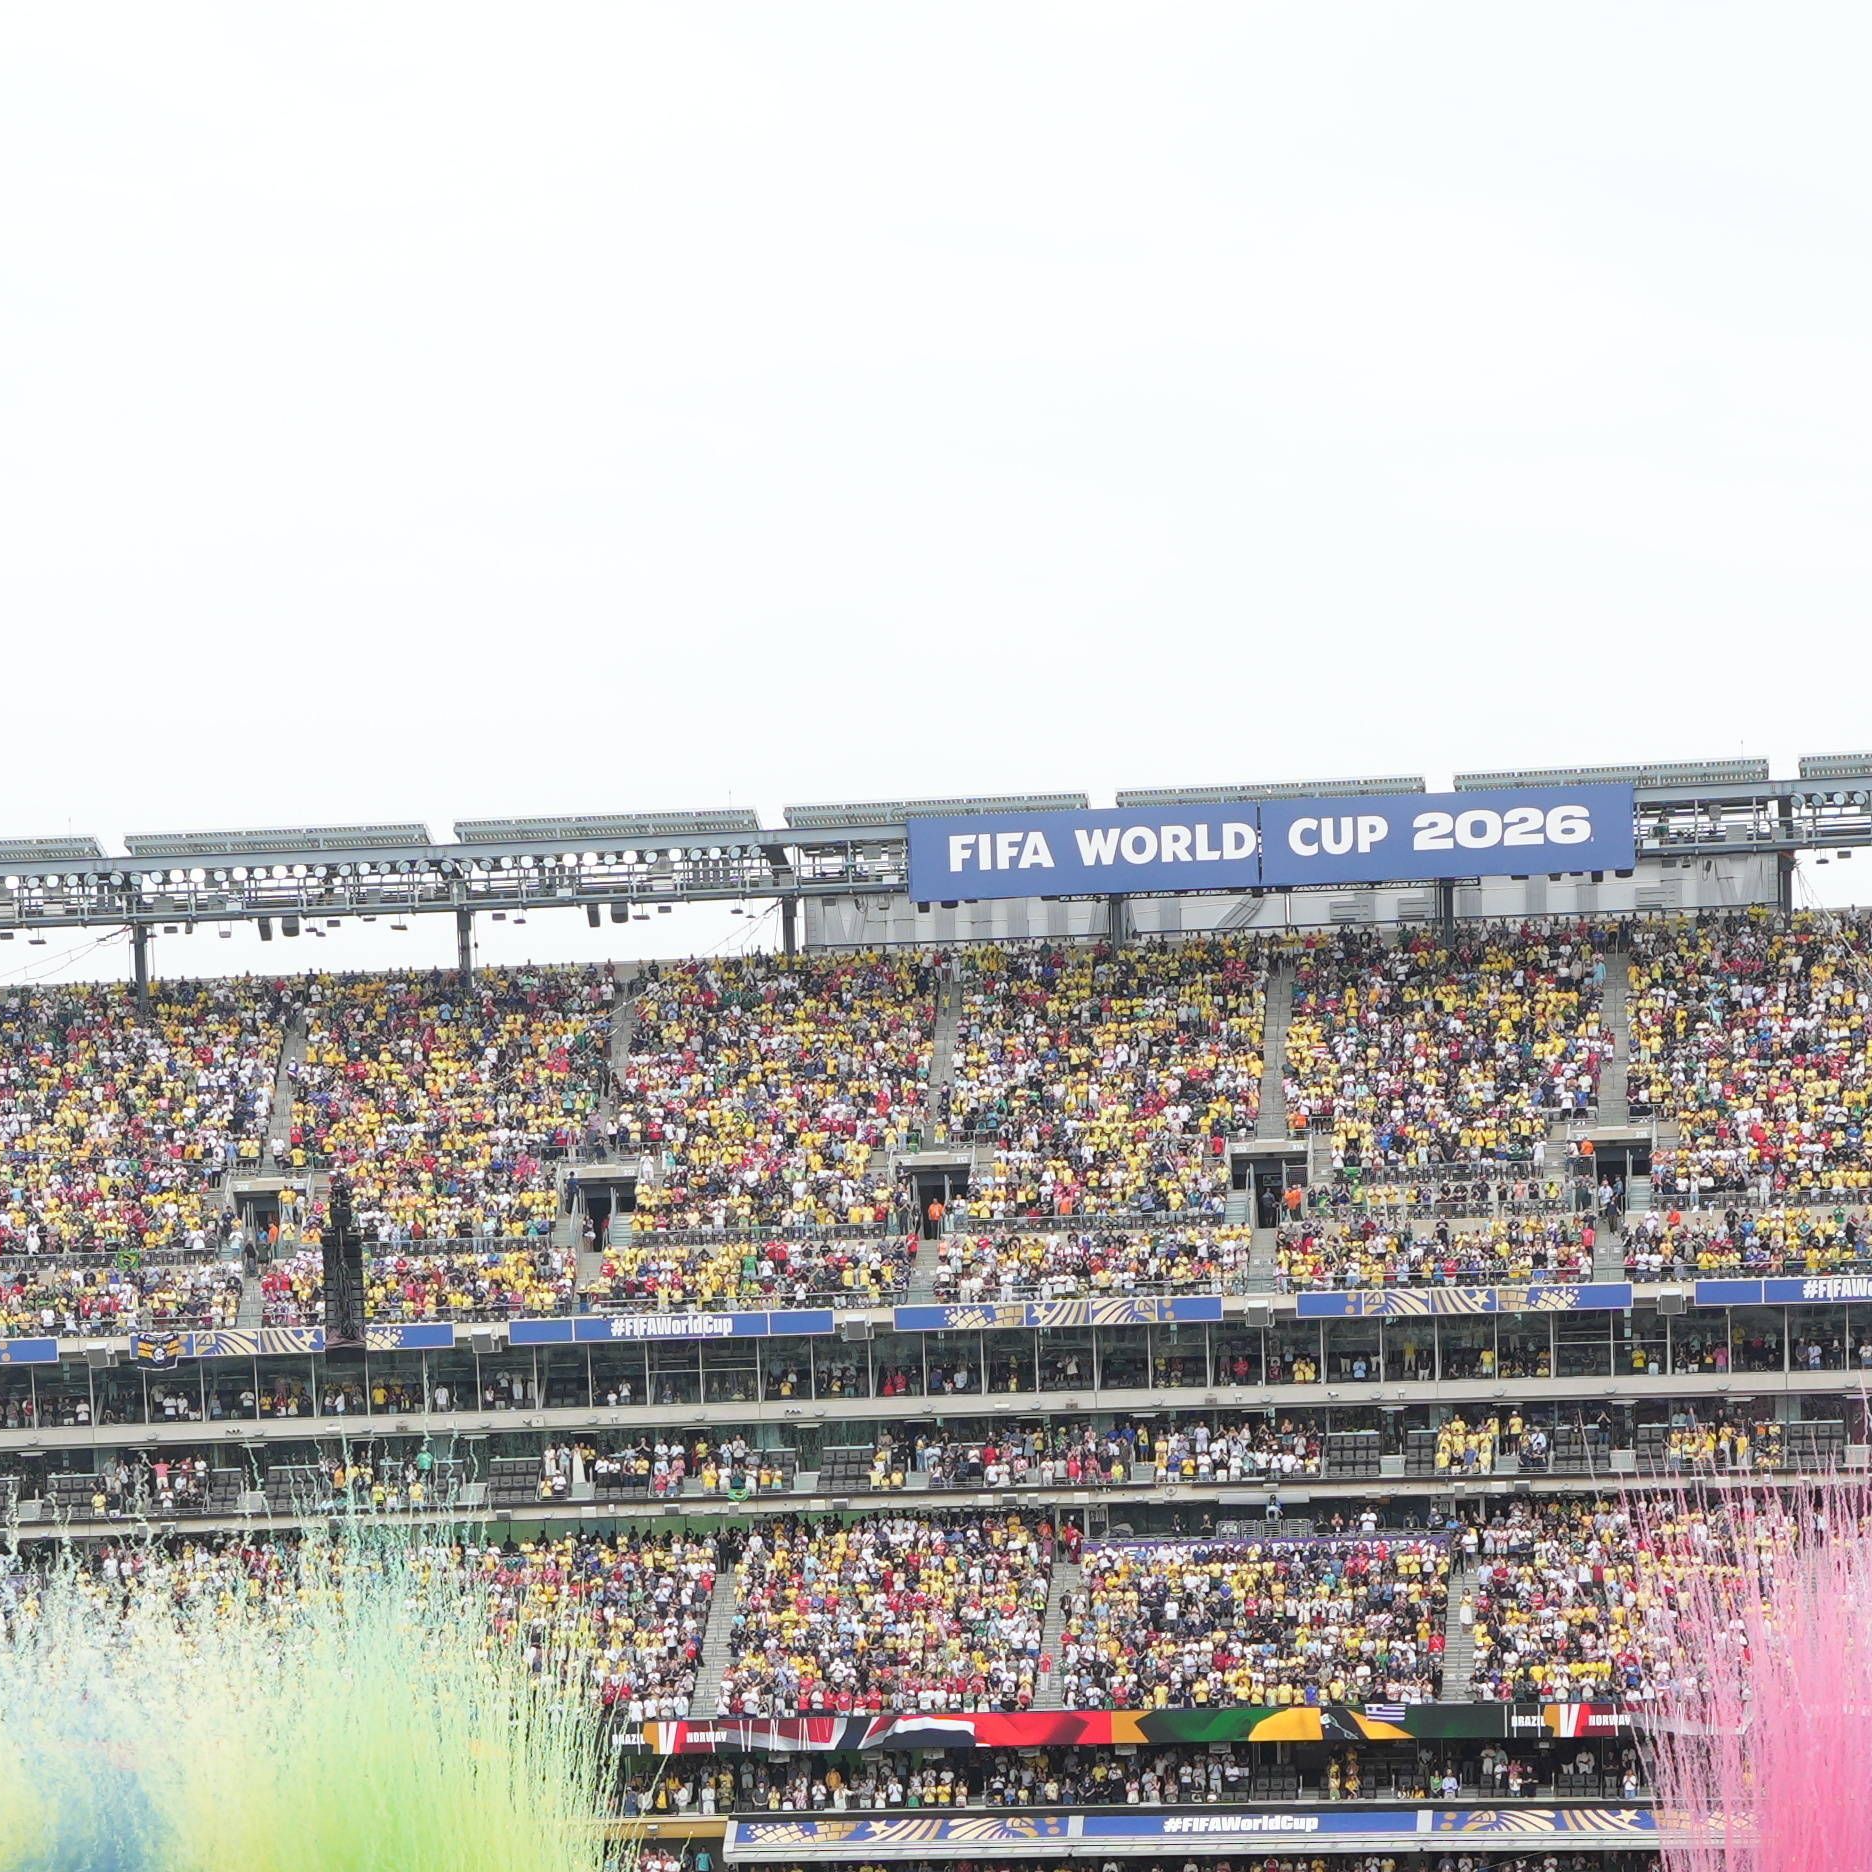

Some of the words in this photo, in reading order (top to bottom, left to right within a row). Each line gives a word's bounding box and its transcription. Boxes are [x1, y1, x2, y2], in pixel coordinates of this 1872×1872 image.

[949, 829, 1054, 873] FIFA
[1074, 820, 1256, 867] WORLD
[1288, 815, 1389, 857] CUP
[1412, 804, 1592, 851] 2026
[610, 1315, 733, 1336] #FIFAWorldCup
[1511, 1715, 1546, 1727] BRAZIL
[1559, 1704, 1581, 1737] V
[658, 1721, 678, 1754] V
[1163, 1815, 1318, 1833] #FIFAWorldCup
